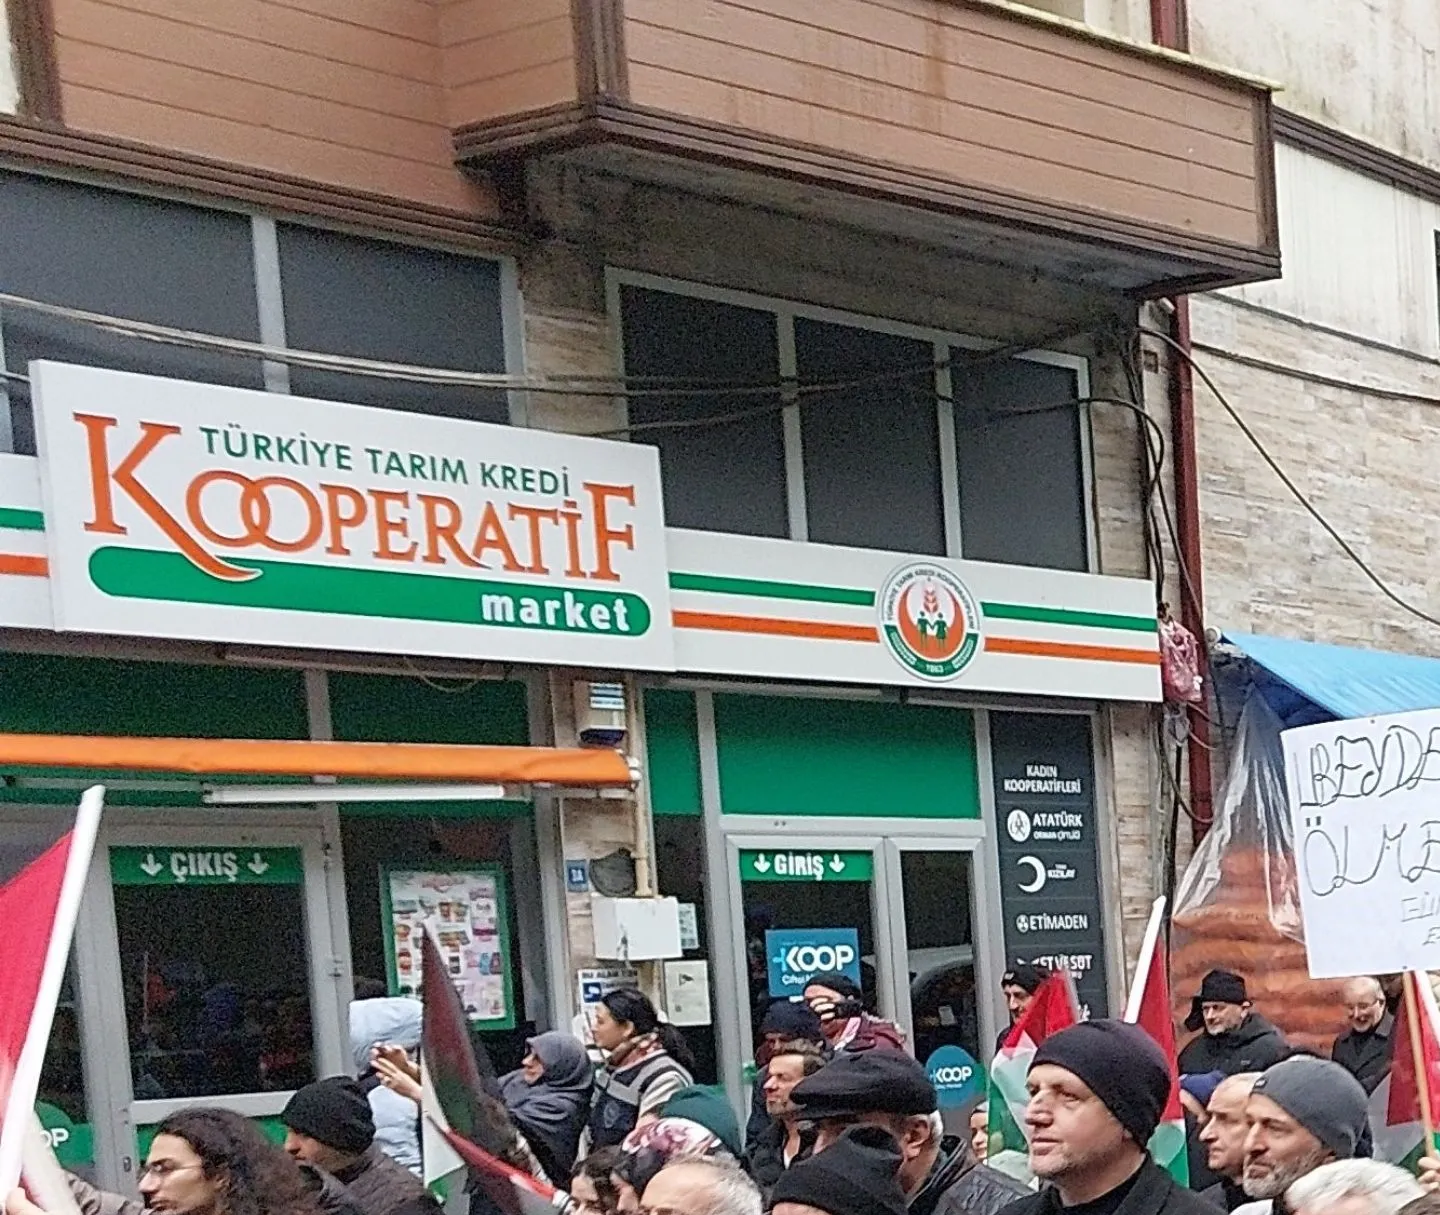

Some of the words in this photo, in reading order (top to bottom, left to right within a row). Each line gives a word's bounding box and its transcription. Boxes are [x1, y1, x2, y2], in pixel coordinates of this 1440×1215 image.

[199, 423, 352, 471] TÜRKİYE
[364, 446, 469, 485] TARIM
[480, 463, 571, 498] KREDİ
[73, 411, 636, 583] KOOPERATİF
[481, 590, 630, 632] market
[1032, 811, 1084, 828] ATATÜRK
[170, 850, 238, 883] ÇIKIŞ
[773, 851, 825, 882] GİRİŞ
[772, 944, 855, 973] KOOP
[930, 1065, 973, 1084] KOOP
